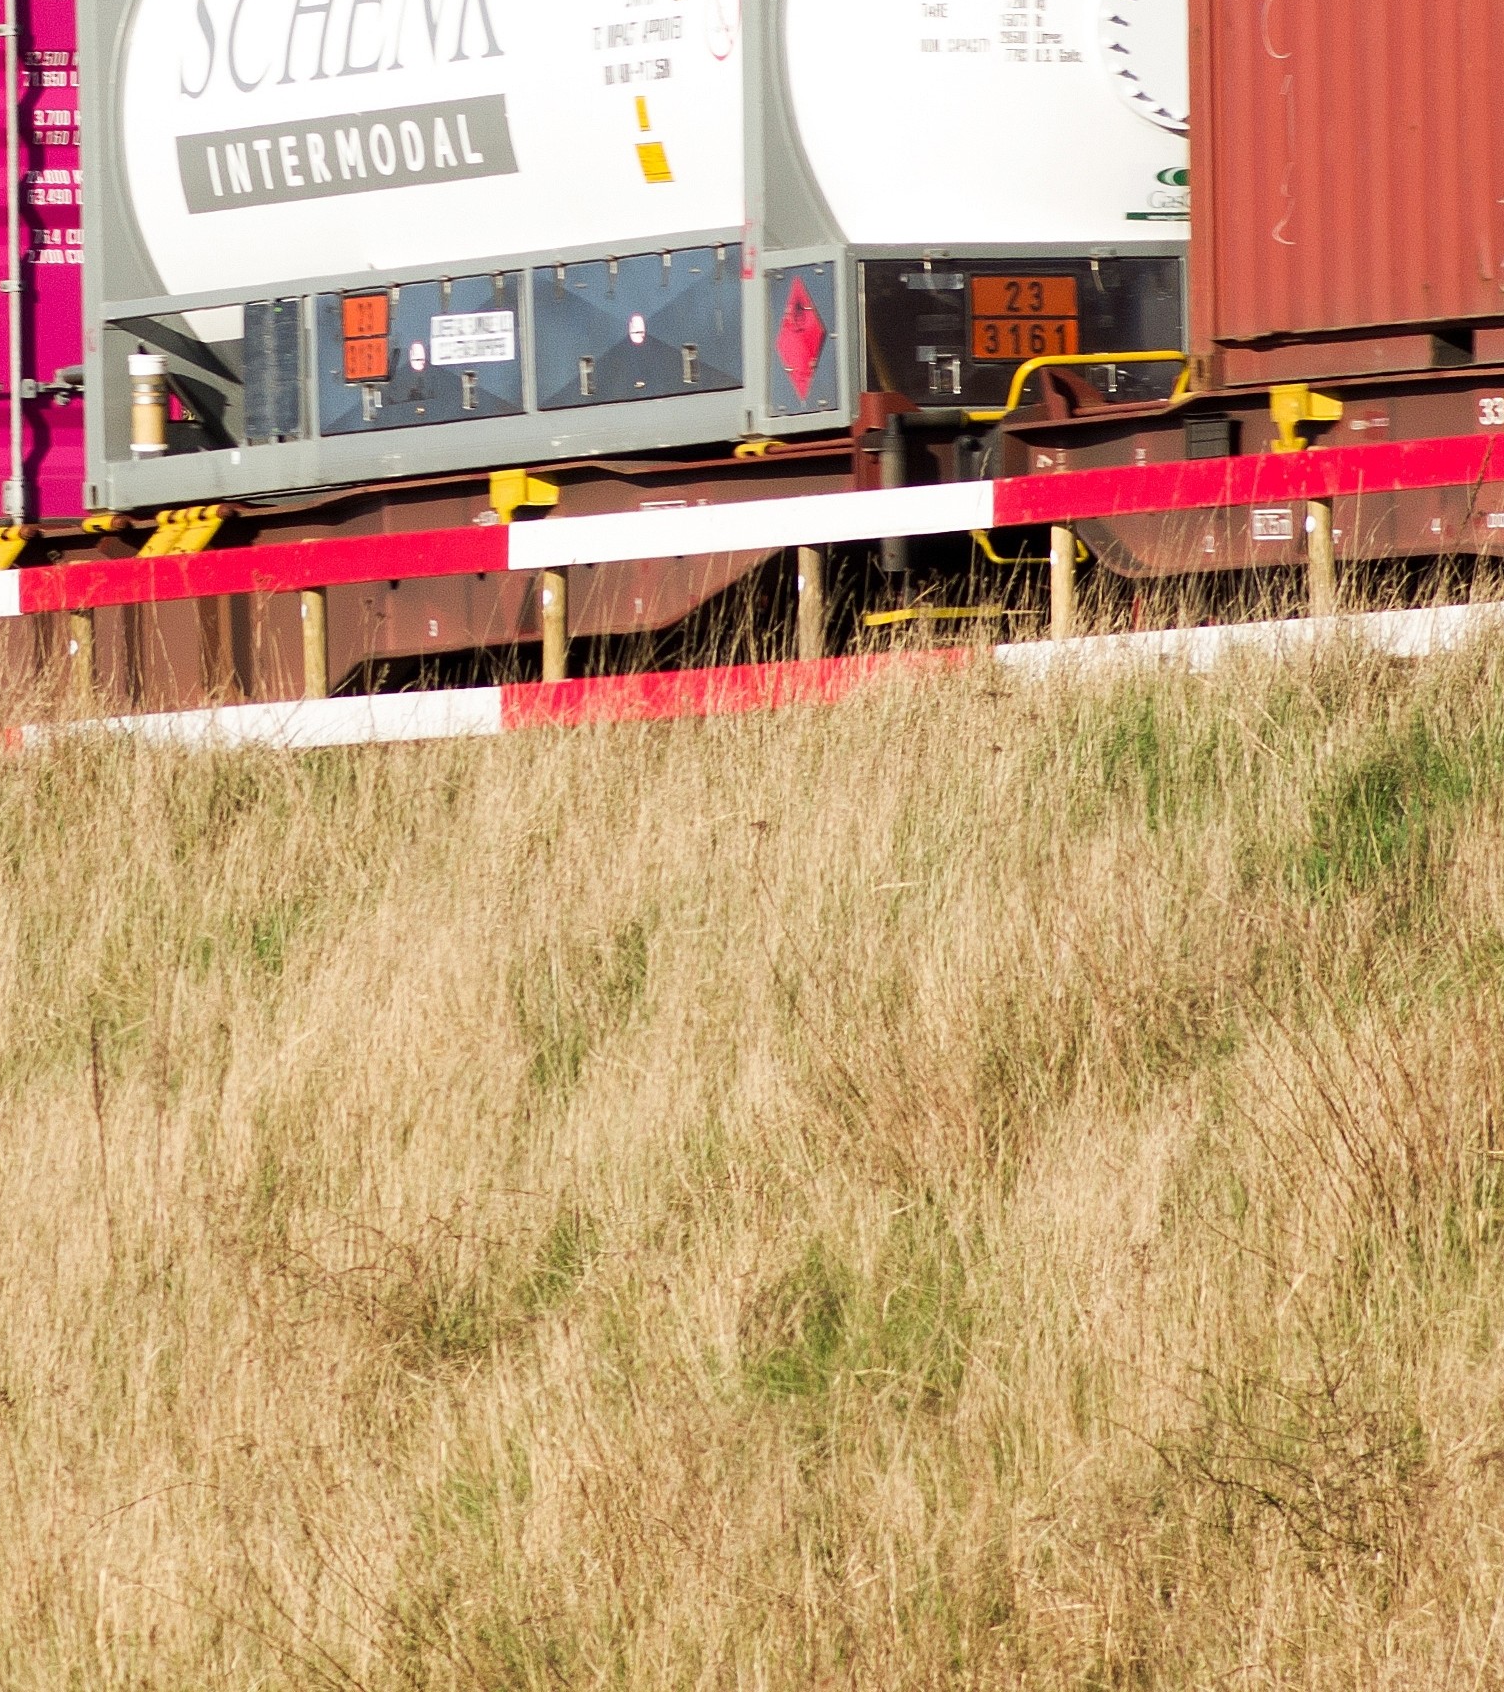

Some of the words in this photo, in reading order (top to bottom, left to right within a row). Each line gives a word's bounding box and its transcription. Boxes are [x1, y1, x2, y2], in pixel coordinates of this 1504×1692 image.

[205, 113, 485, 198] INTERMODAL
[1004, 281, 1035, 312] 23
[983, 324, 1068, 355] 3161
